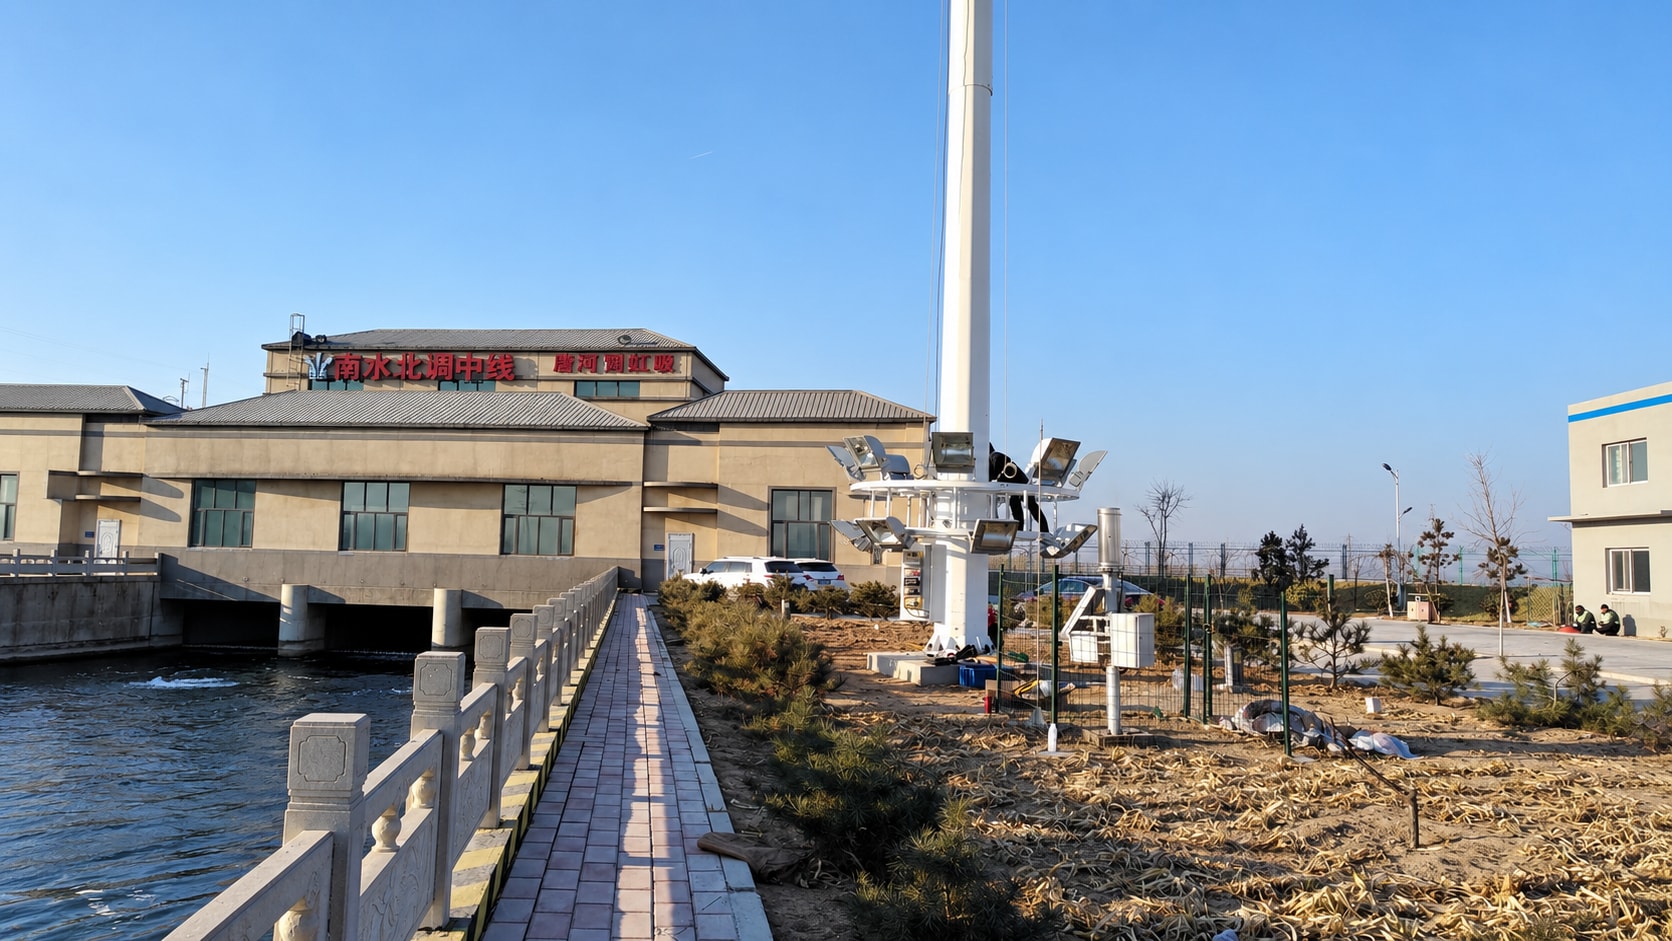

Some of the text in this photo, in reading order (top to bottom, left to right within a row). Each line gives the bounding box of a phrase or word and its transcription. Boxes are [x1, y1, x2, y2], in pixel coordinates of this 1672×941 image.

[334, 352, 516, 381] 南水北调中线
